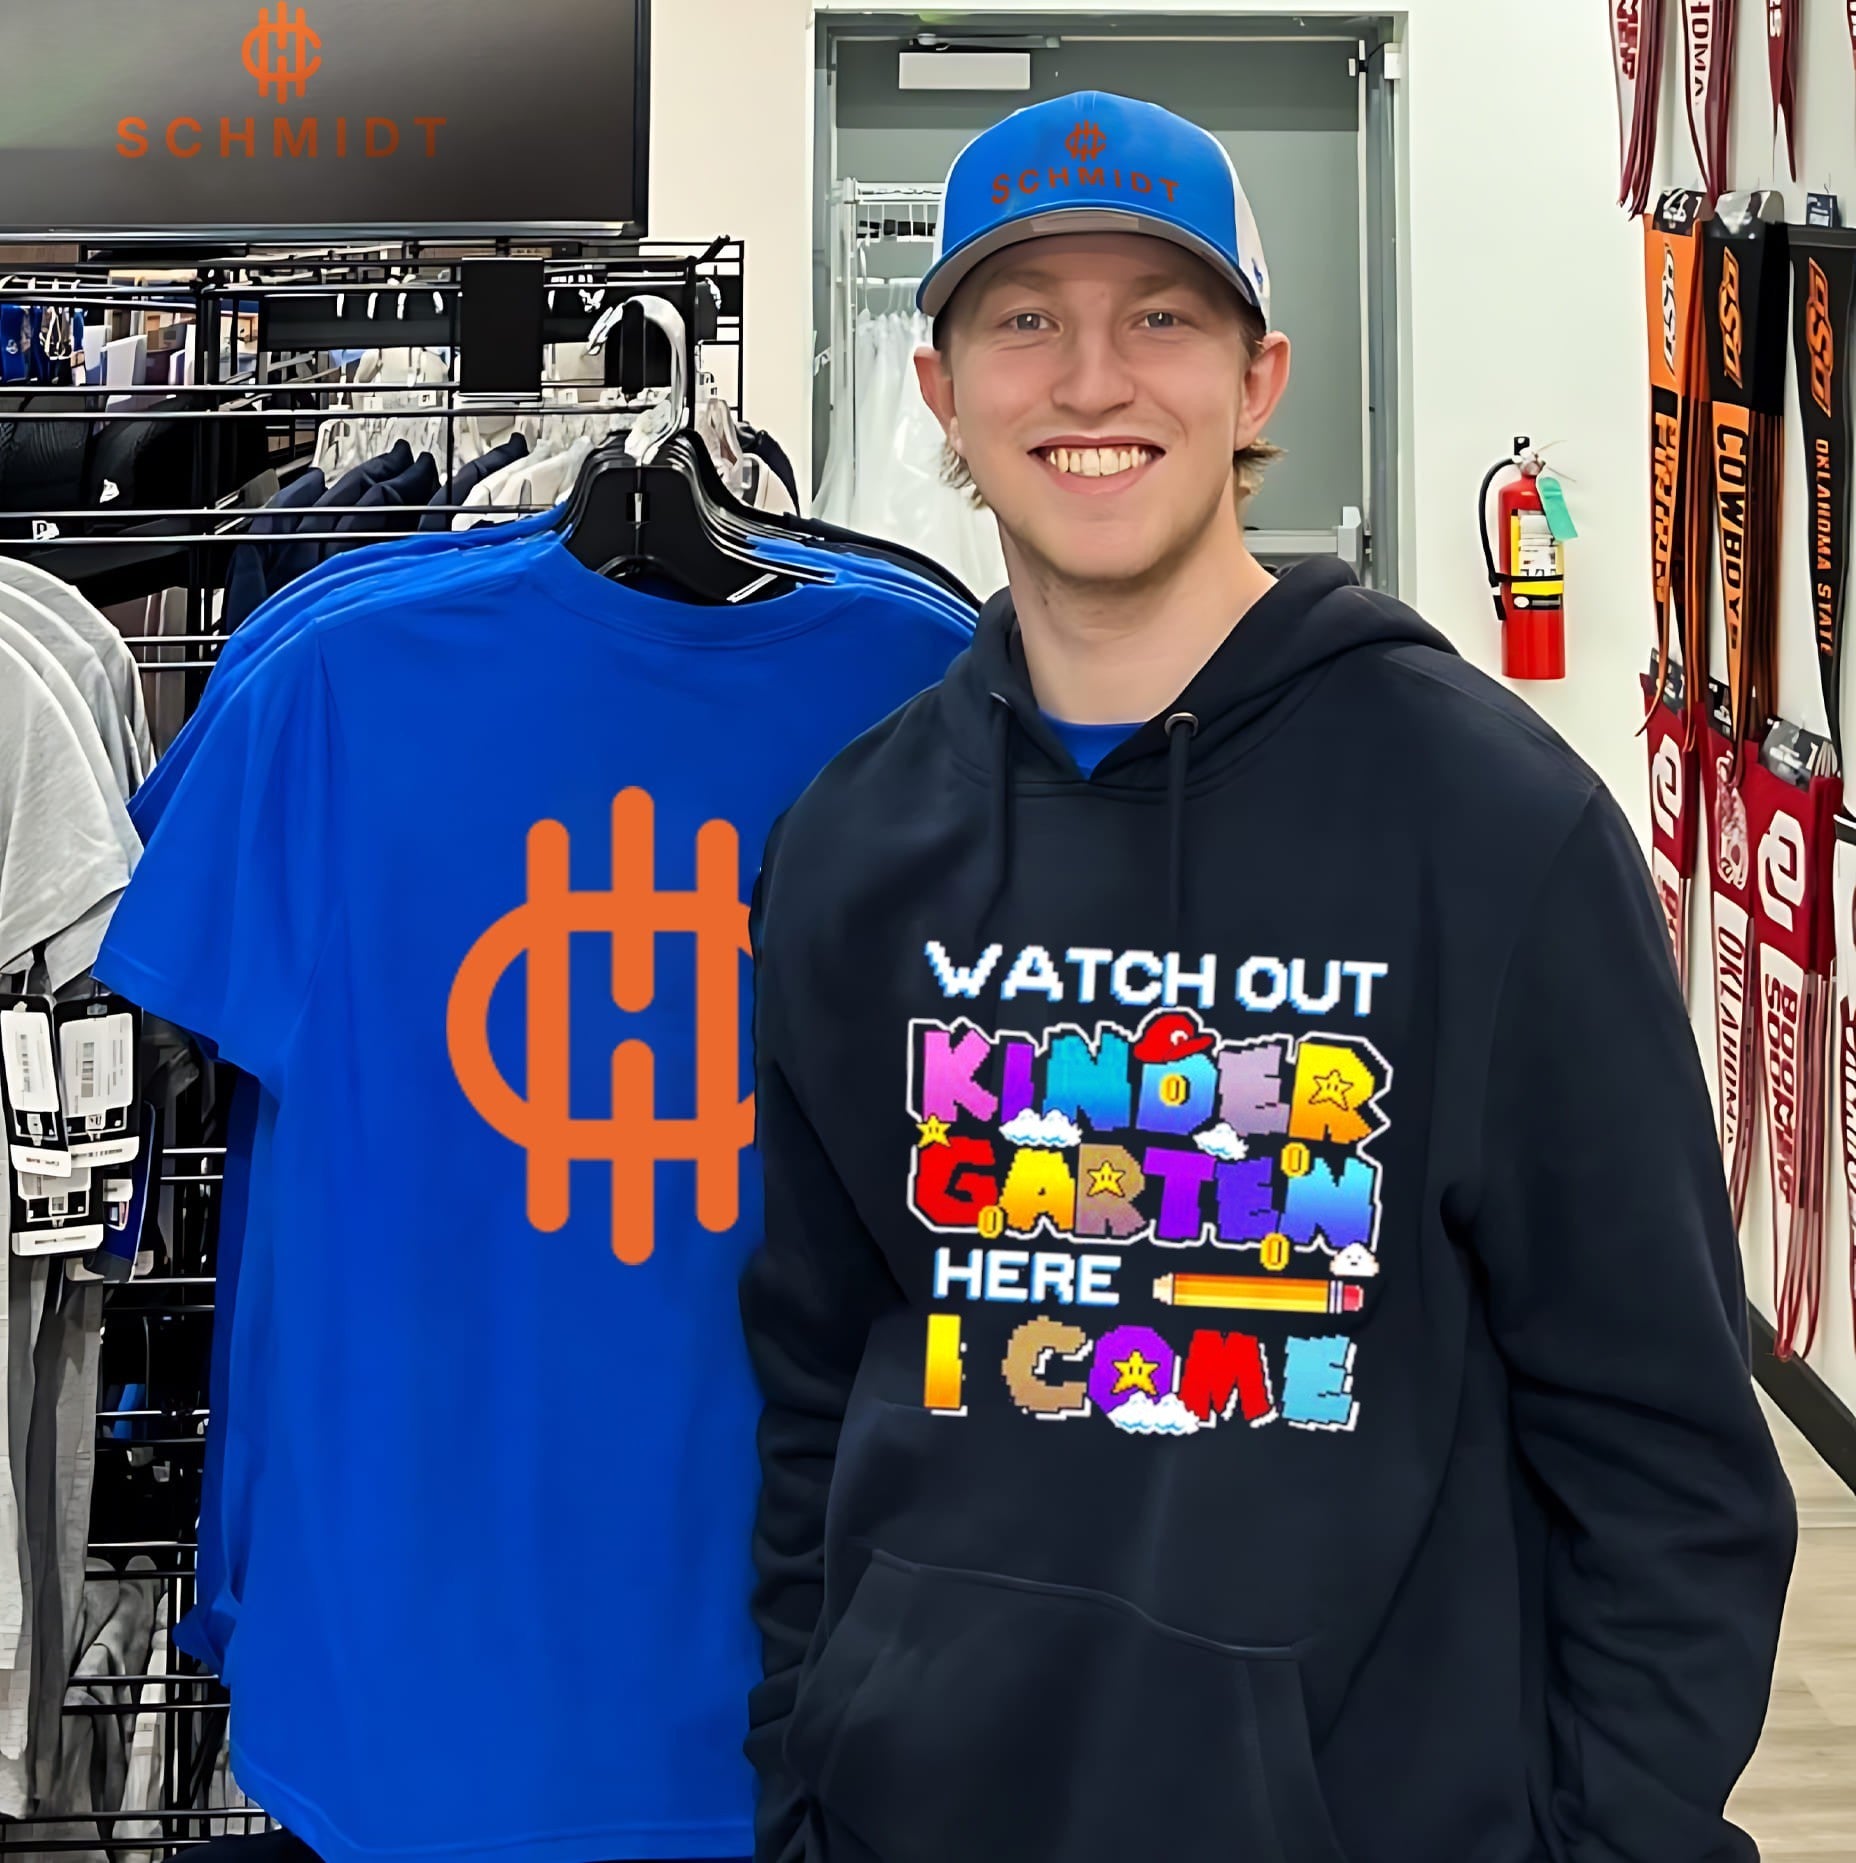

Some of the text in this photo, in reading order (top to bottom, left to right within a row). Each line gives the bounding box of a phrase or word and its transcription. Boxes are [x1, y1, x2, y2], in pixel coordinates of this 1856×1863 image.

[115, 116, 448, 159] SCHMIDT
[991, 166, 1179, 204] SCHMIDT
[1815, 438, 1832, 570] OKLAHOMA
[924, 940, 1389, 1017] WATCH OUT
[921, 1025, 1376, 1145] KINDER
[914, 1135, 1376, 1248] GARTEN
[932, 1246, 1122, 1306] HERE
[923, 1313, 1360, 1432] I COME
